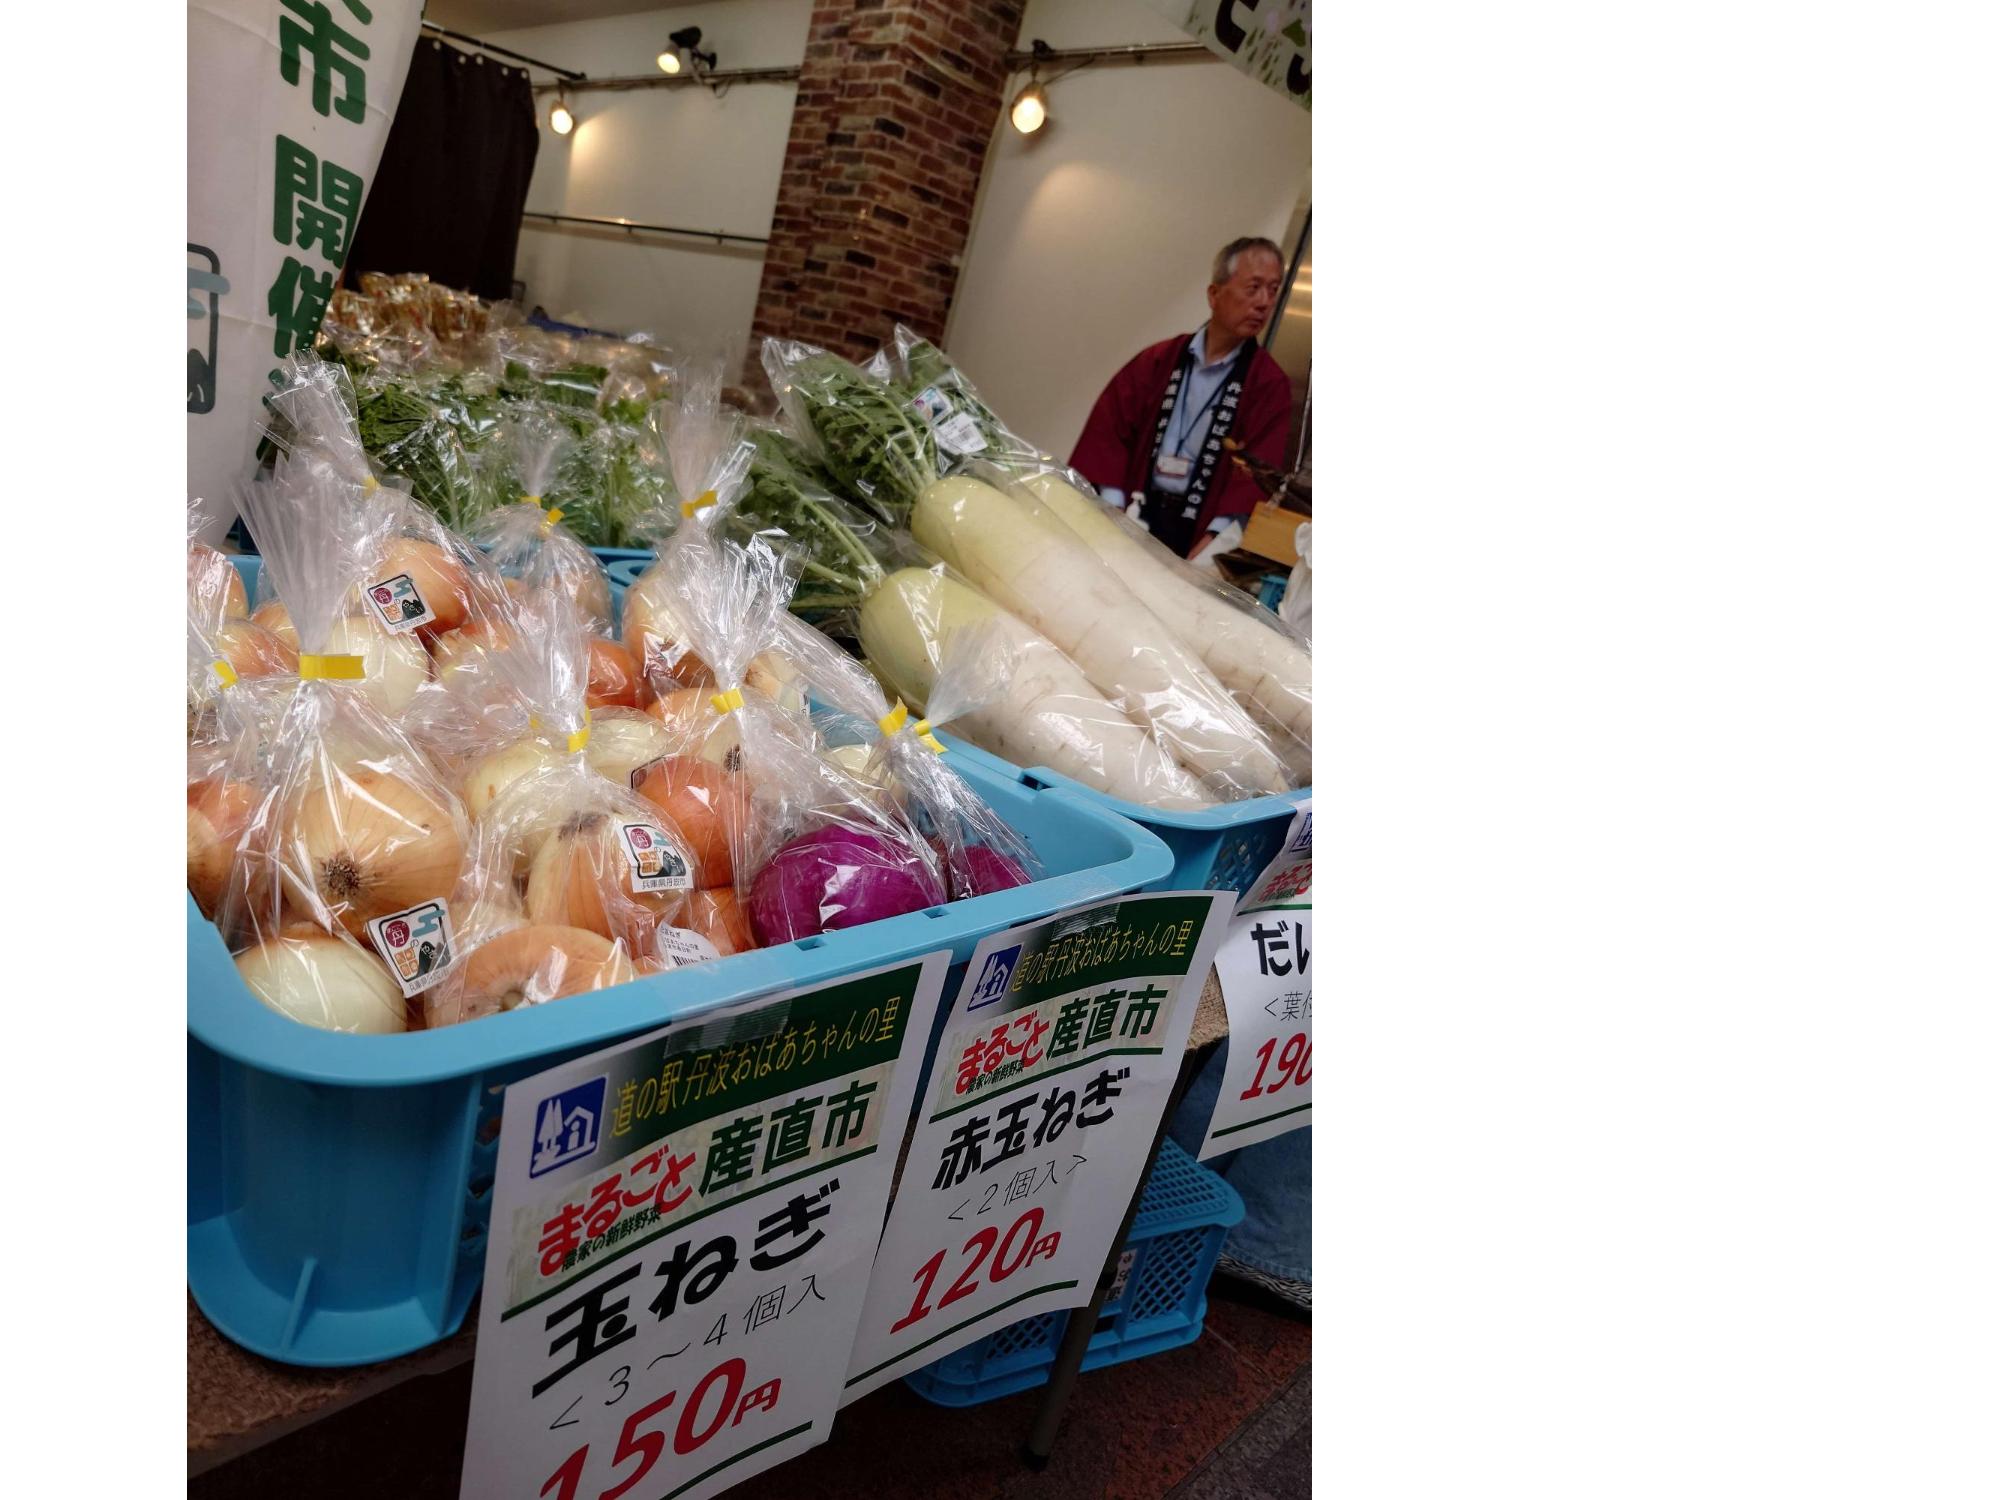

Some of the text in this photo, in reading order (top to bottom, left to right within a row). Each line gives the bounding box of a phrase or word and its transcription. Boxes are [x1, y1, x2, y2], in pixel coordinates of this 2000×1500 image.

[1011, 918, 1194, 993] 道の駅丹波おばあちゃんの里
[608, 996, 901, 1139] 道の駅丹波おばあちゃんの里
[955, 984, 1169, 1095] まるごと 産直市
[538, 1080, 878, 1276] まるごと 産直市
[931, 1066, 1131, 1190] 赤玉ねぎ
[532, 1178, 841, 1399] 玉ねぎ
[561, 1204, 662, 1272] 農家の新鮮野菜
[890, 1207, 1062, 1335] 120円
[540, 1357, 782, 1500] 150円
